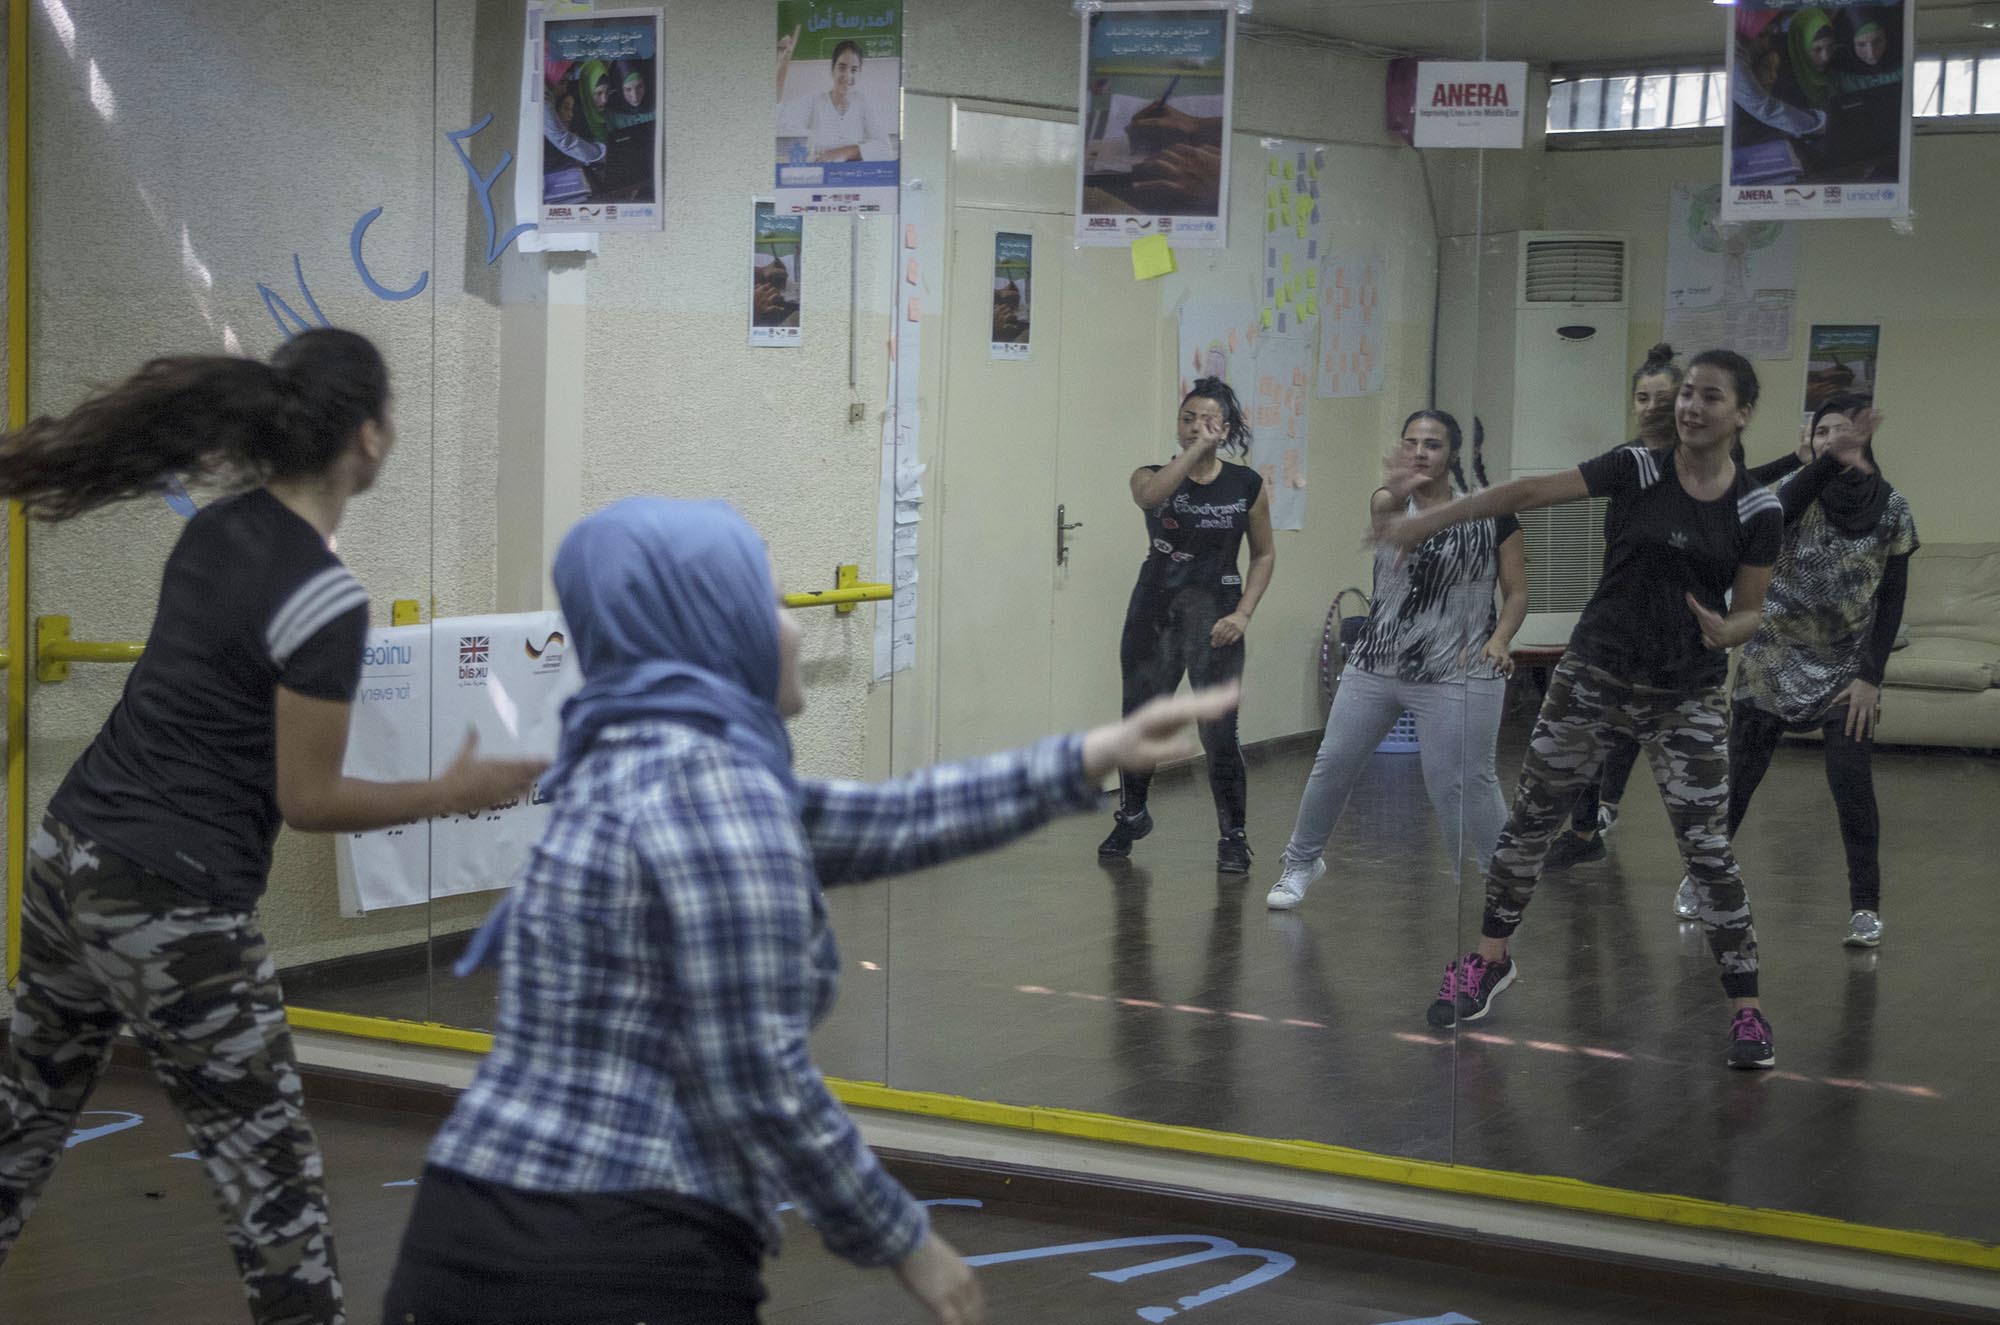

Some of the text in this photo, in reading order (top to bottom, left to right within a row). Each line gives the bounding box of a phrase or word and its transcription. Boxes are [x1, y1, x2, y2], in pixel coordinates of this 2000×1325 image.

[835, 10, 894, 31] المدرسة
[1431, 83, 1509, 107] ANERA
[1738, 189, 1773, 201] ANERA
[1846, 189, 1882, 202] unicef
[1088, 217, 1117, 228] ANERA
